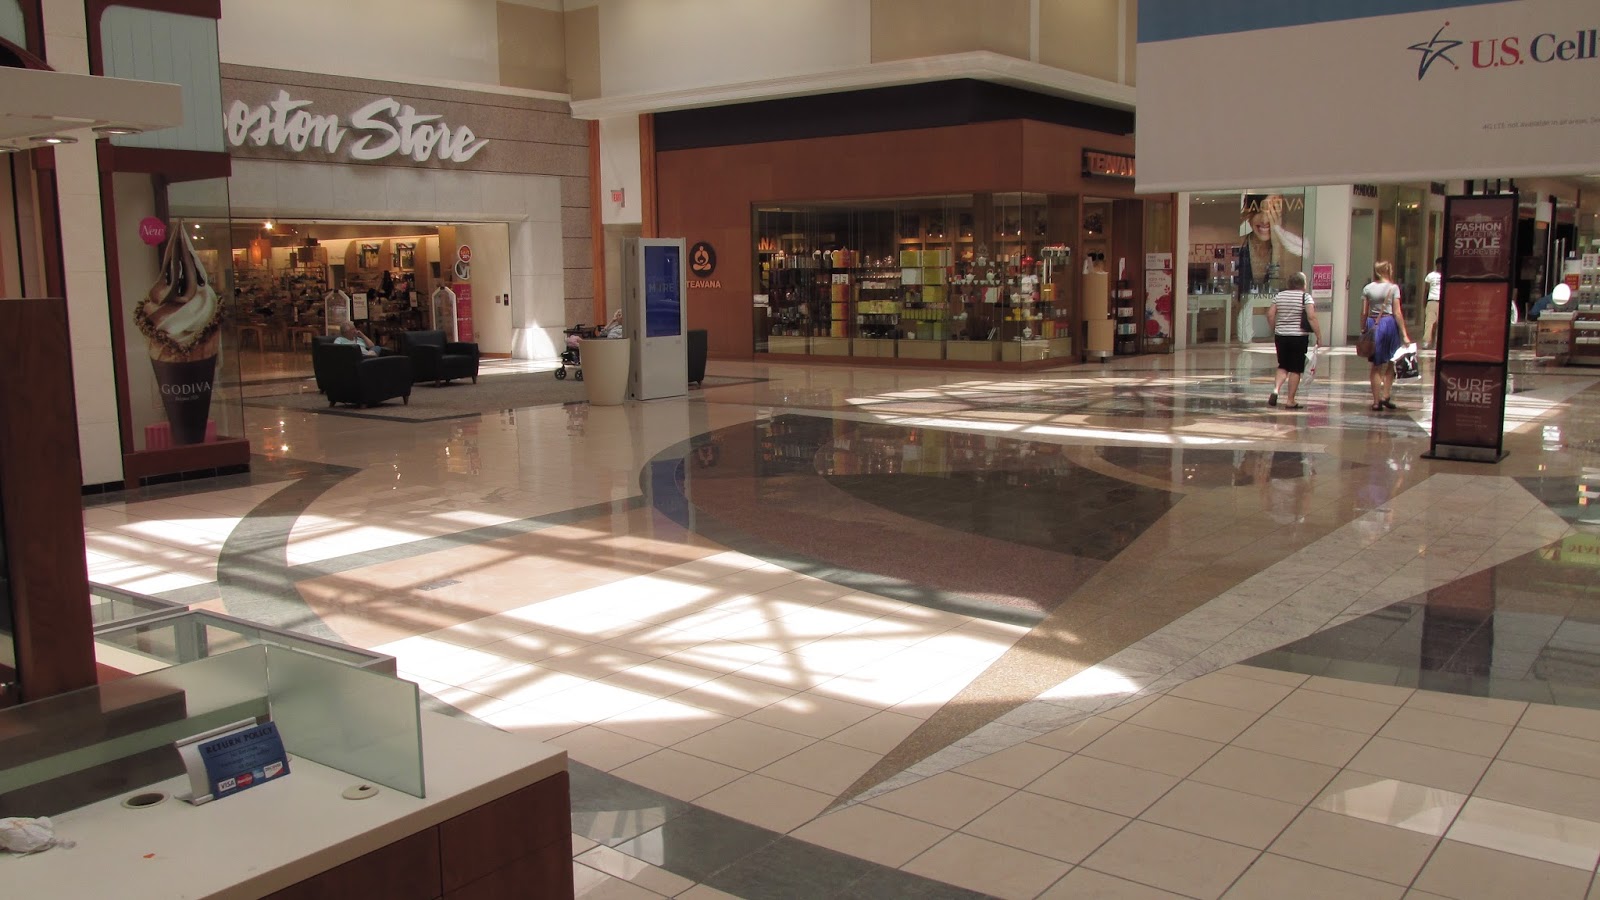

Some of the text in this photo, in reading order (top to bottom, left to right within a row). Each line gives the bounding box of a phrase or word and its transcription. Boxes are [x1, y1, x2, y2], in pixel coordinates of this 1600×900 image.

[1470, 29, 1600, 69] U.S. Cell
[224, 89, 489, 163] oston Store
[141, 225, 167, 236] New
[1455, 222, 1502, 231] FASHION
[1454, 237, 1501, 248] STYLE
[1313, 272, 1332, 280] FREE
[648, 282, 675, 293] MRE
[686, 280, 721, 289] TEAVANA
[161, 381, 211, 395] GODIVA
[1447, 377, 1493, 392] SURF
[207, 726, 272, 753] RETURN POLICY
[221, 780, 235, 789] VISA
